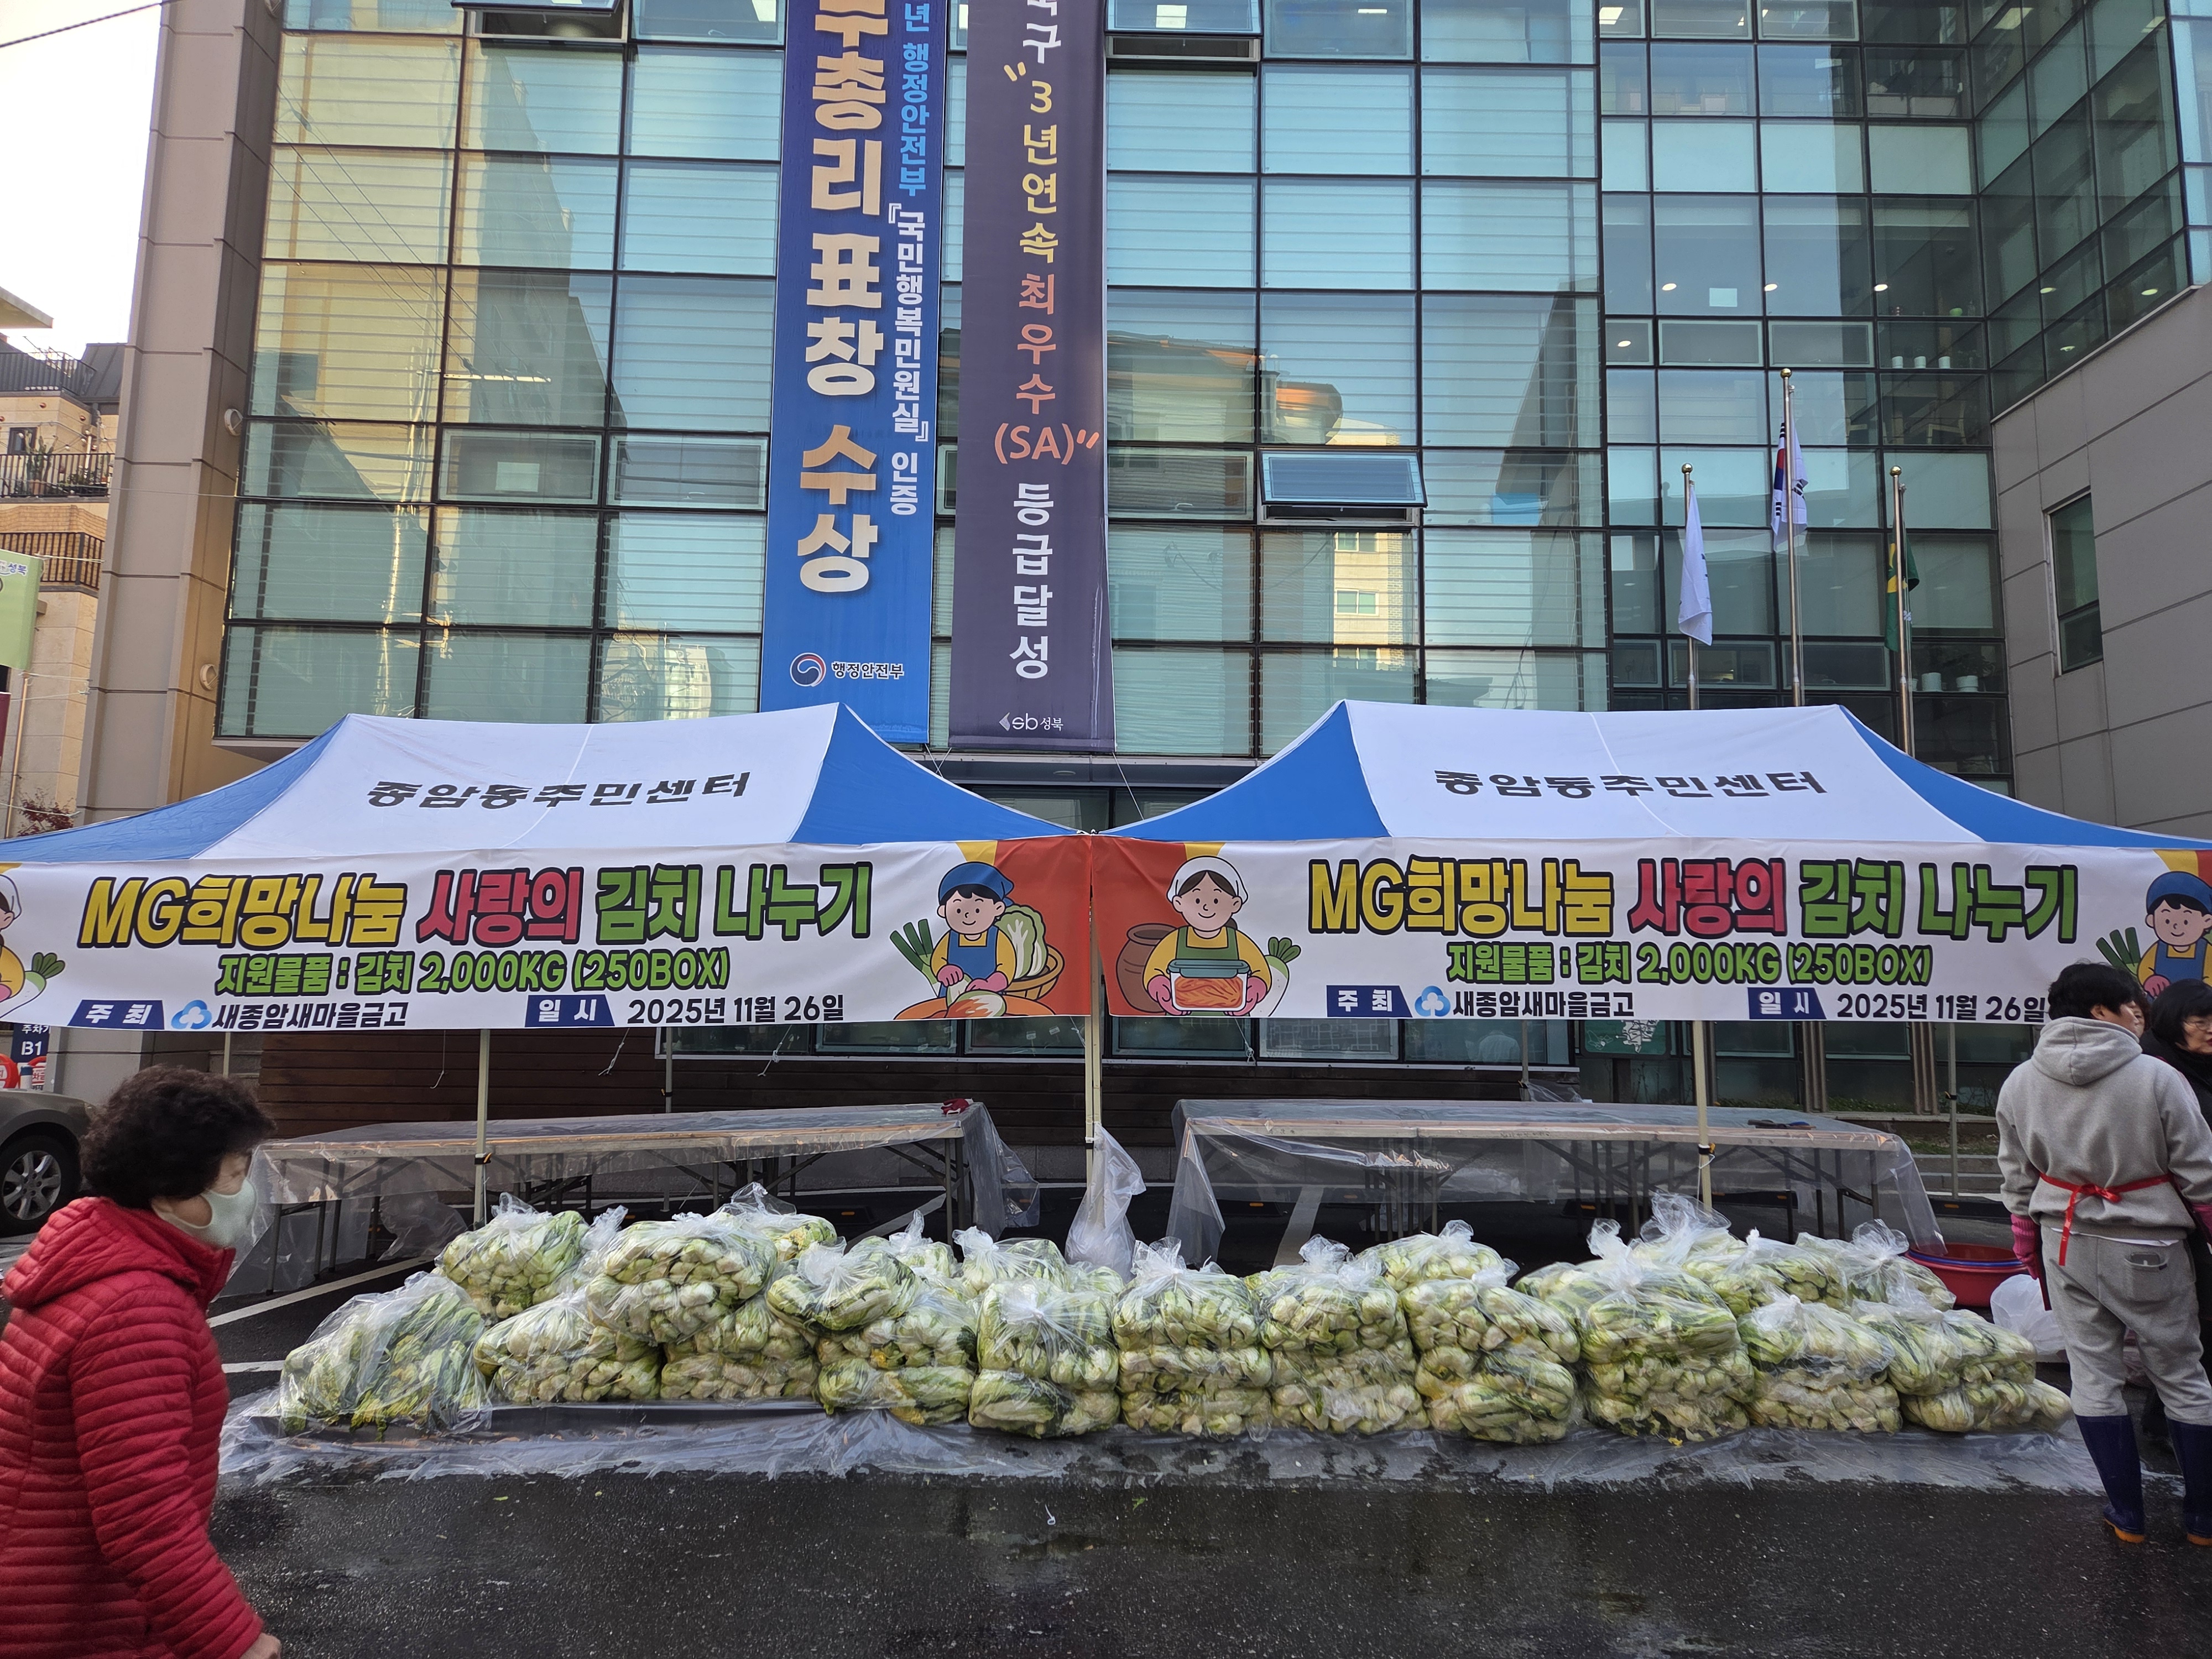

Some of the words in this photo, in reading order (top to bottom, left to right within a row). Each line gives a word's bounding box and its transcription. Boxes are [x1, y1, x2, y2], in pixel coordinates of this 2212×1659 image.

[899, 43, 930, 197] 행정안전부
[805, 232, 884, 396] 표창
[890, 451, 919, 516] 인증
[797, 424, 879, 593] 수상
[1009, 482, 1054, 679] 등급달성
[832, 662, 904, 680] 행정안전부
[367, 771, 750, 810] 종암동주민센터
[1434, 770, 1828, 799] 종암동주민센터
[77, 872, 408, 950] MG희망나눔
[416, 867, 585, 947] 사랑의
[594, 863, 703, 946] 김치
[713, 861, 874, 942] 나누기
[1308, 853, 1616, 938] MG희망나눔
[1627, 857, 1788, 939] 사랑의
[1798, 857, 1906, 939] 김치
[1918, 862, 2079, 944] 나누기
[215, 953, 334, 997] 지원물품
[354, 951, 415, 995] 김치
[417, 949, 568, 994] 2,000KG
[571, 946, 730, 992] (250BOX)
[1446, 940, 1555, 985] 지원물품
[1576, 940, 1632, 984] 김치
[1636, 941, 1782, 986] 2,000KG
[1786, 942, 1934, 986] (250BOX)
[212, 1001, 409, 1030] 새종암새마을금고
[627, 998, 725, 1025] 2025년
[733, 996, 776, 1023] 11월
[784, 994, 844, 1022] 26일
[1453, 991, 1635, 1018] 새종암새마을금고
[1837, 993, 1928, 1020] 2025년
[1936, 995, 1977, 1021] 11월
[1985, 996, 2046, 1022] 26일
[21, 1041, 42, 1056] B1
